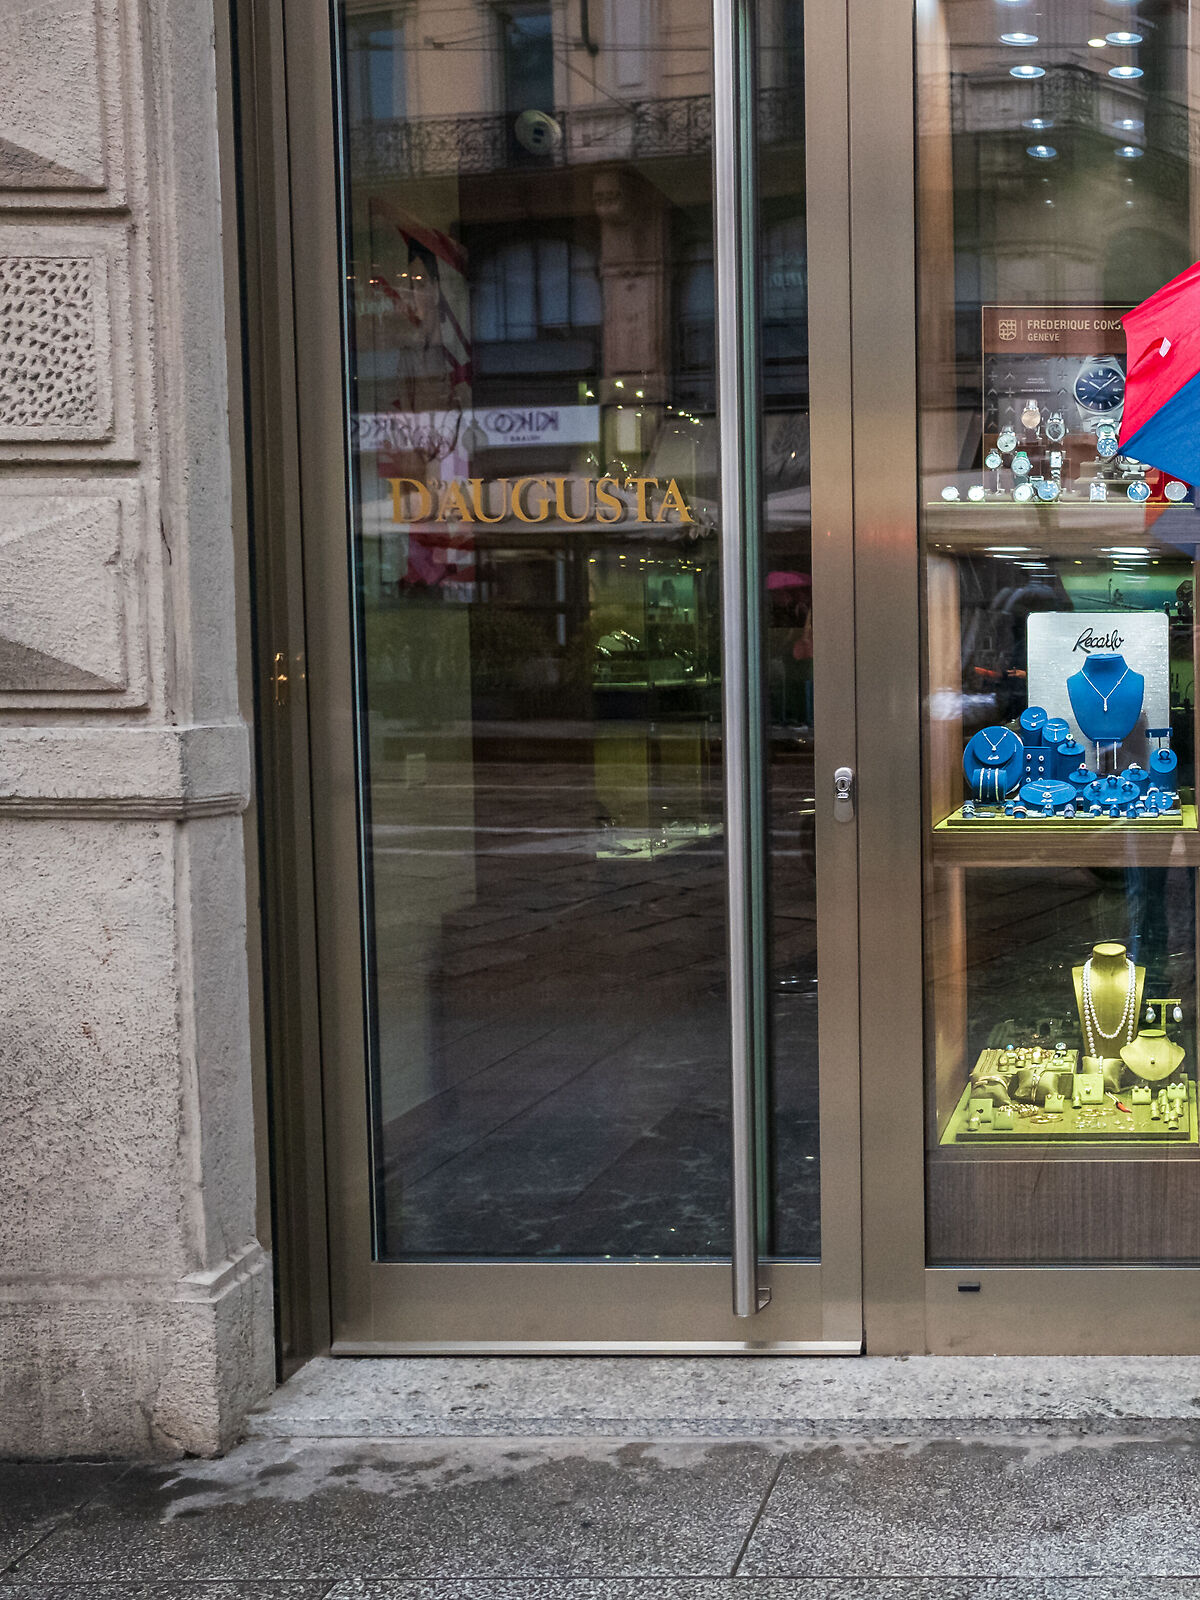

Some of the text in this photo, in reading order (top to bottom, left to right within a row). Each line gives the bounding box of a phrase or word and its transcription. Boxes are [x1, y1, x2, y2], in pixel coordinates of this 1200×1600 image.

[1027, 319, 1090, 331] FREDERIQUE
[1027, 333, 1060, 342] GENEVE
[389, 477, 696, 524] D'AUGUSTA
[1072, 627, 1125, 654] Recarlo
